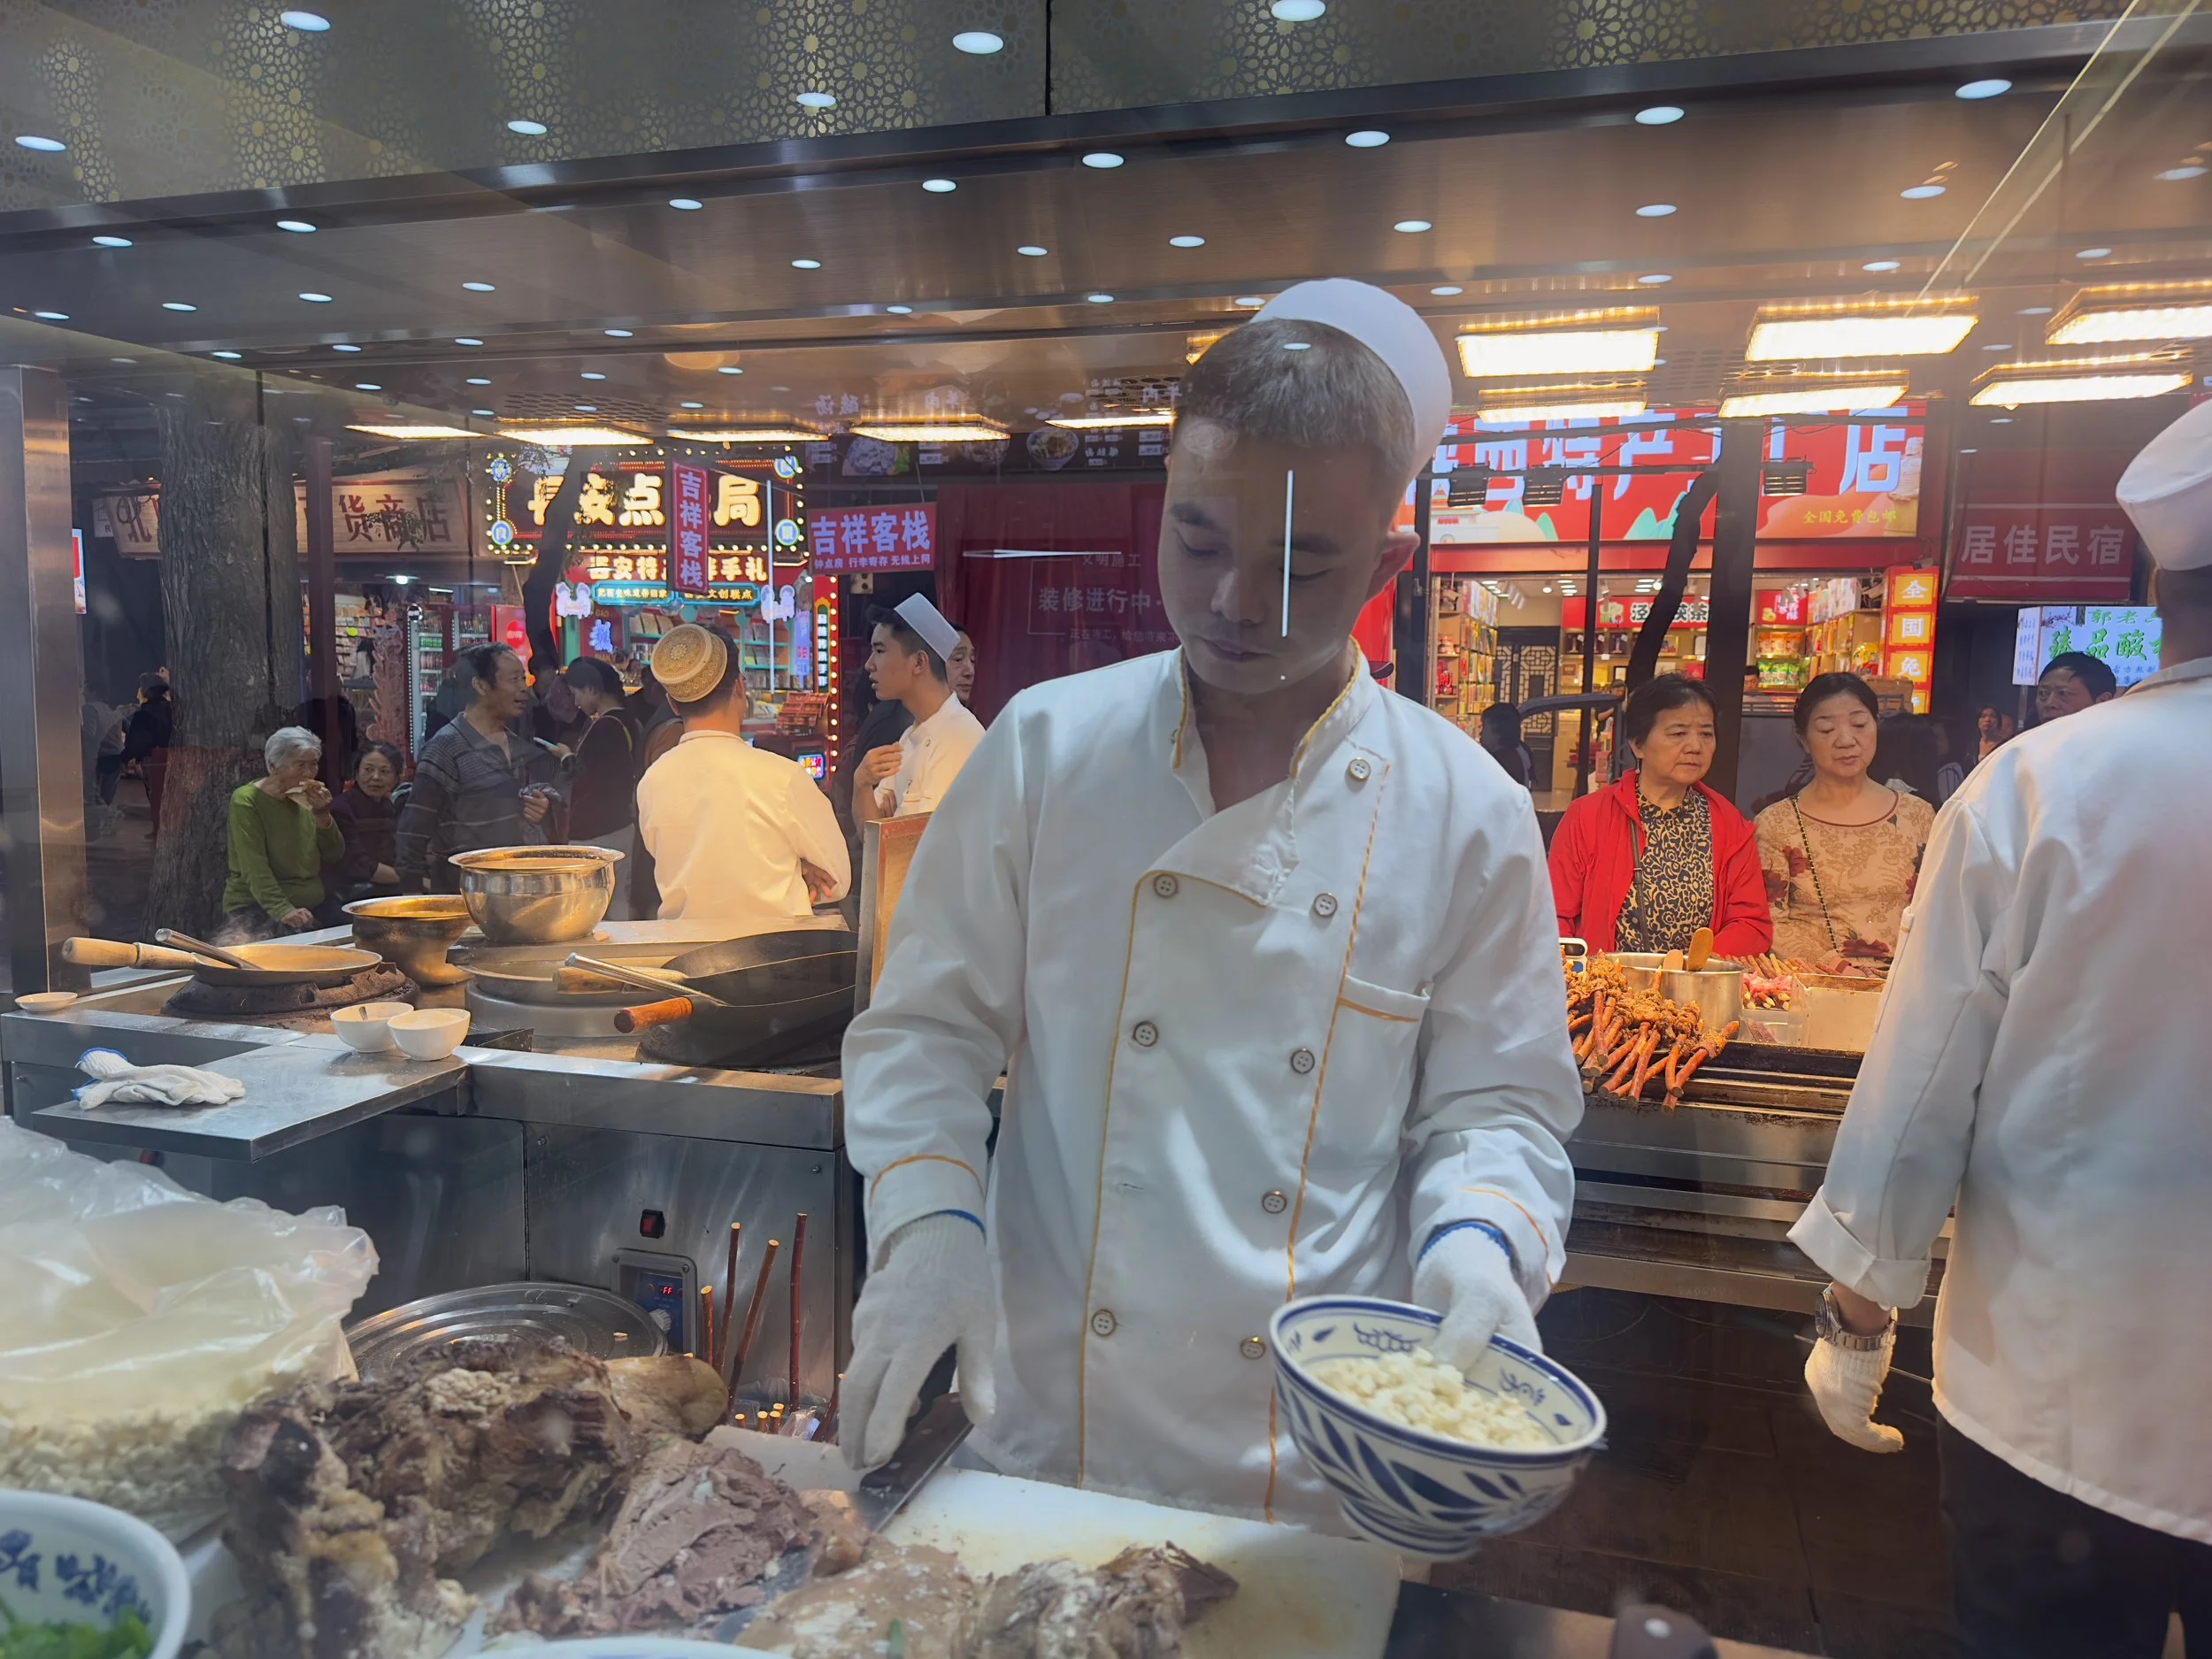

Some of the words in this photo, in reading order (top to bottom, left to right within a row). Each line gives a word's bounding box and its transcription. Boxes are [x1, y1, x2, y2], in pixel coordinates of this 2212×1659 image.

[298, 492, 452, 542] 货商店
[527, 472, 762, 526] 安点局
[1802, 509, 1897, 525] 全国免费包邮
[680, 471, 704, 588] 吉祥客栈
[810, 510, 931, 556] 吉祥客栈
[1961, 524, 2124, 565] 居佳民宿
[589, 556, 768, 581] 西安特手礼
[891, 553, 931, 566] 无线上网
[684, 588, 753, 601] 文创糕点
[1630, 603, 1709, 623] 泾茯茶
[1901, 580, 1928, 706] 全国免
